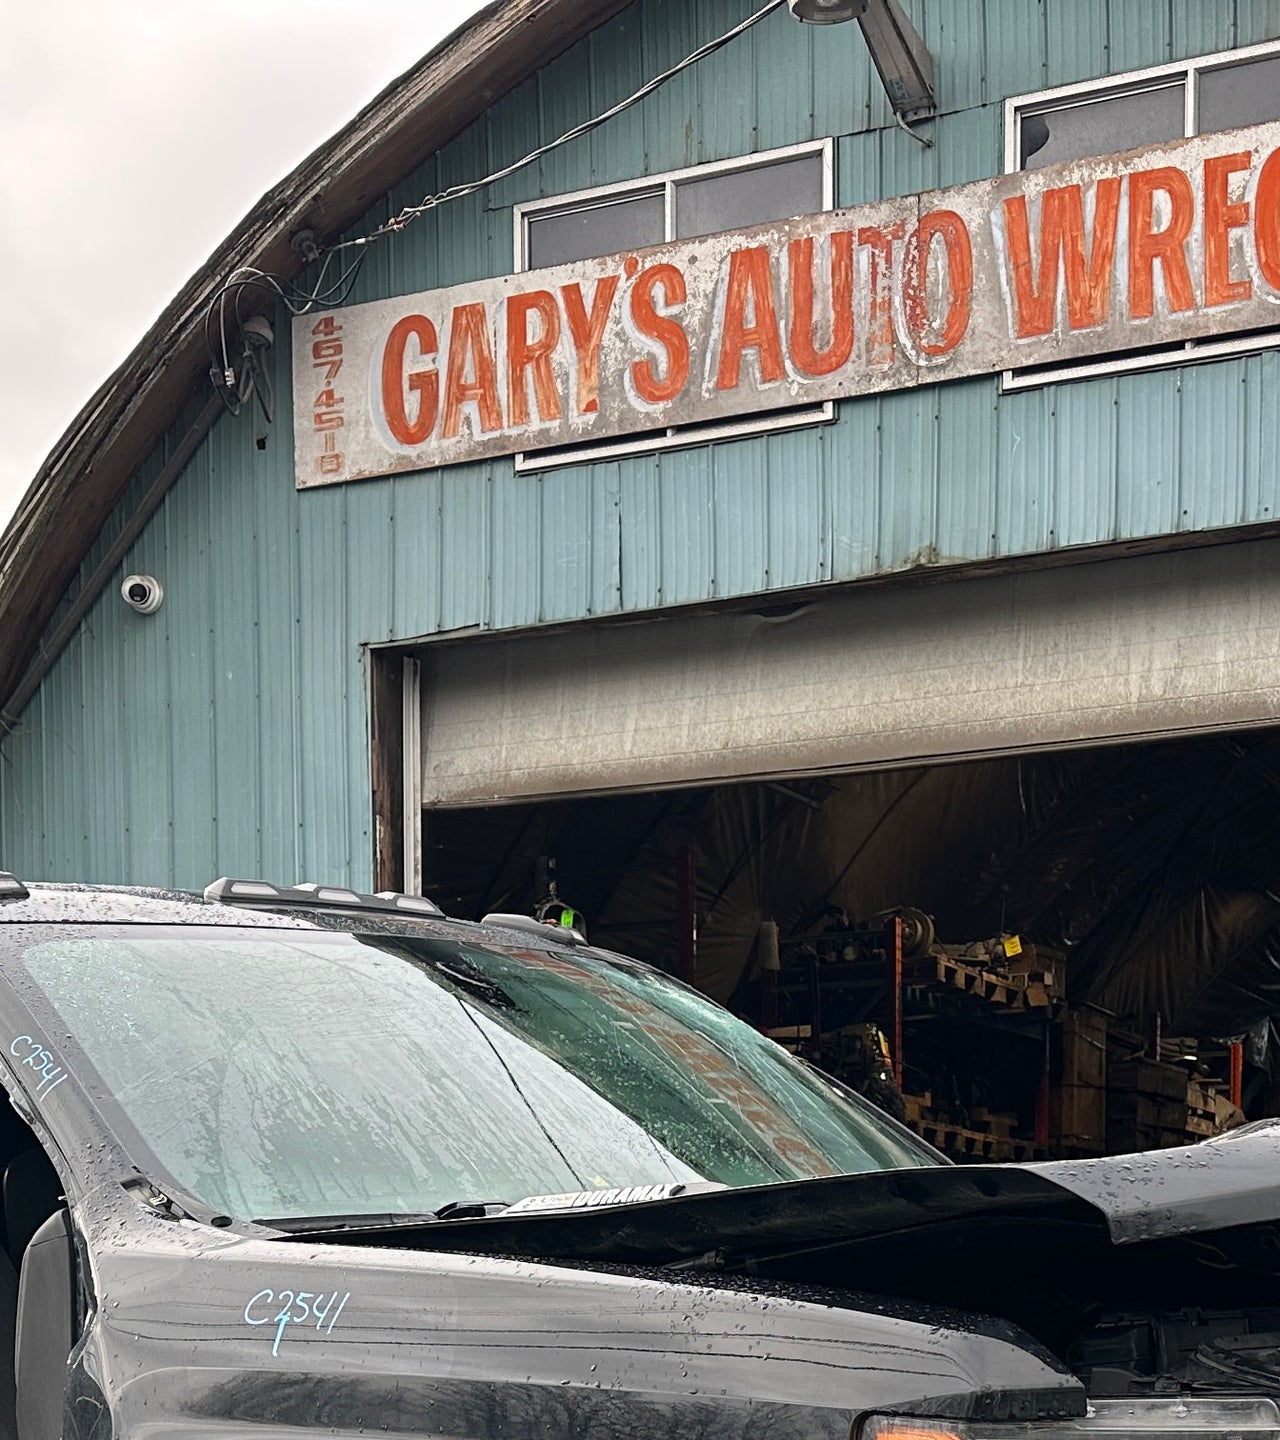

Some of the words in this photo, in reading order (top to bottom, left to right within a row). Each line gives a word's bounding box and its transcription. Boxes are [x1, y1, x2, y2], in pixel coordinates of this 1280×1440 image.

[377, 256, 689, 446] GARY'S
[710, 208, 974, 391] AUTO
[10, 1035, 69, 1102] C2541
[572, 1184, 672, 1208] DURAMAX
